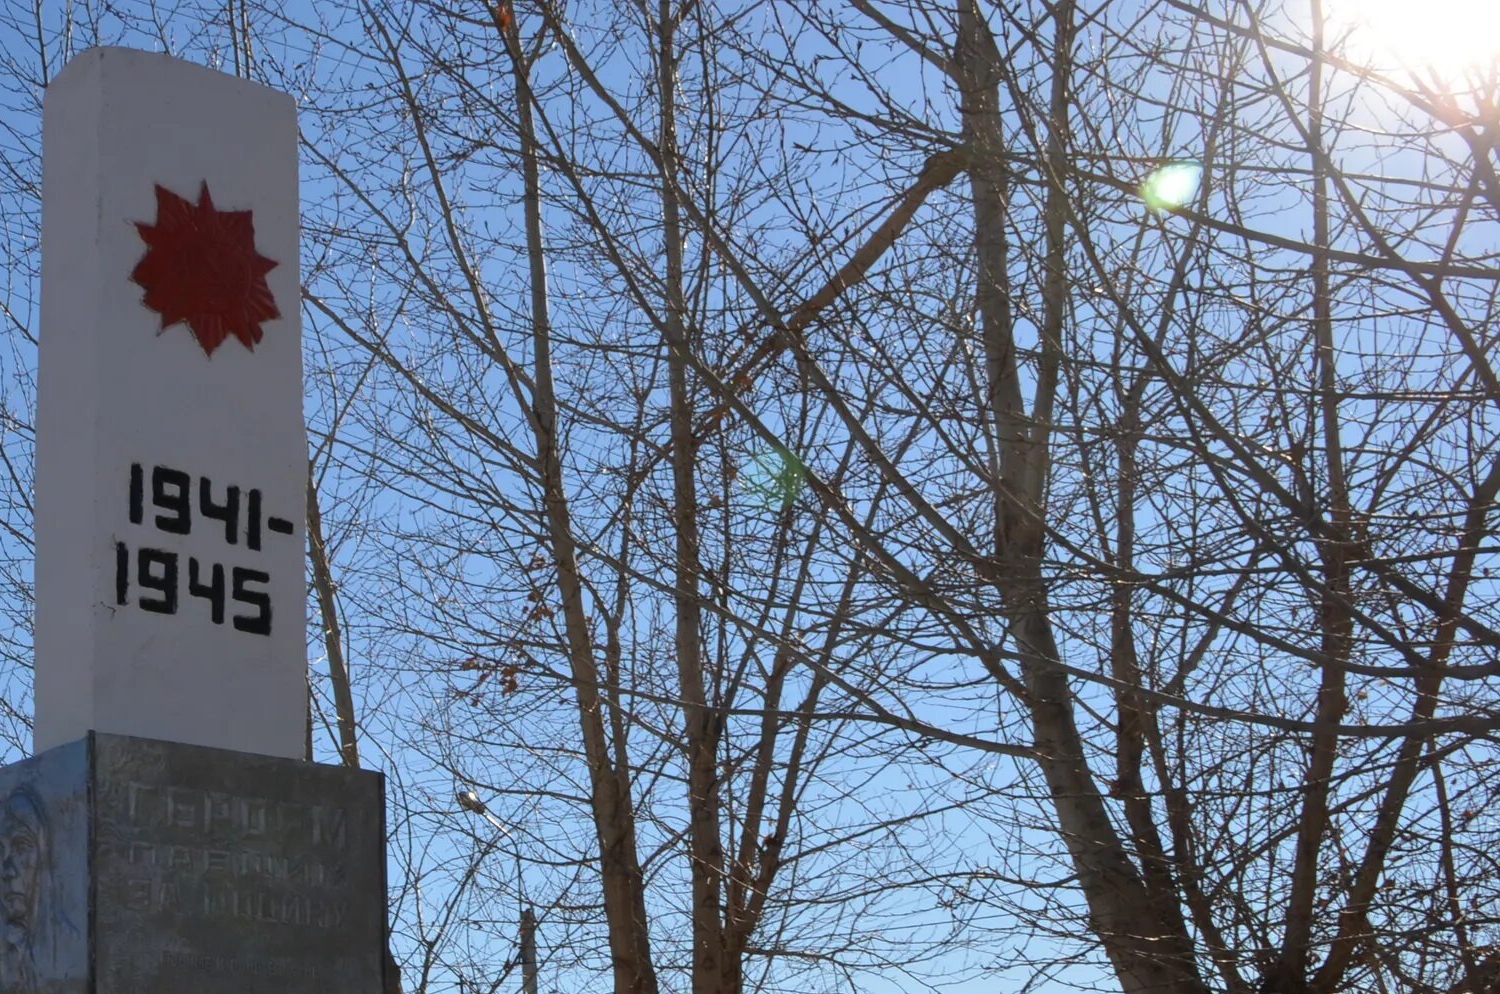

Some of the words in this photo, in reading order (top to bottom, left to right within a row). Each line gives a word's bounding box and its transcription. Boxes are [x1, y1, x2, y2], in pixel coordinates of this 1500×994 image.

[129, 462, 294, 551] 1941-
[115, 541, 272, 636] 1945
[127, 779, 347, 851] ГЕРОЯМ
[127, 840, 347, 886] ПАВШИМ
[127, 877, 180, 913] ЗА
[203, 882, 347, 928] РОДИНУ
